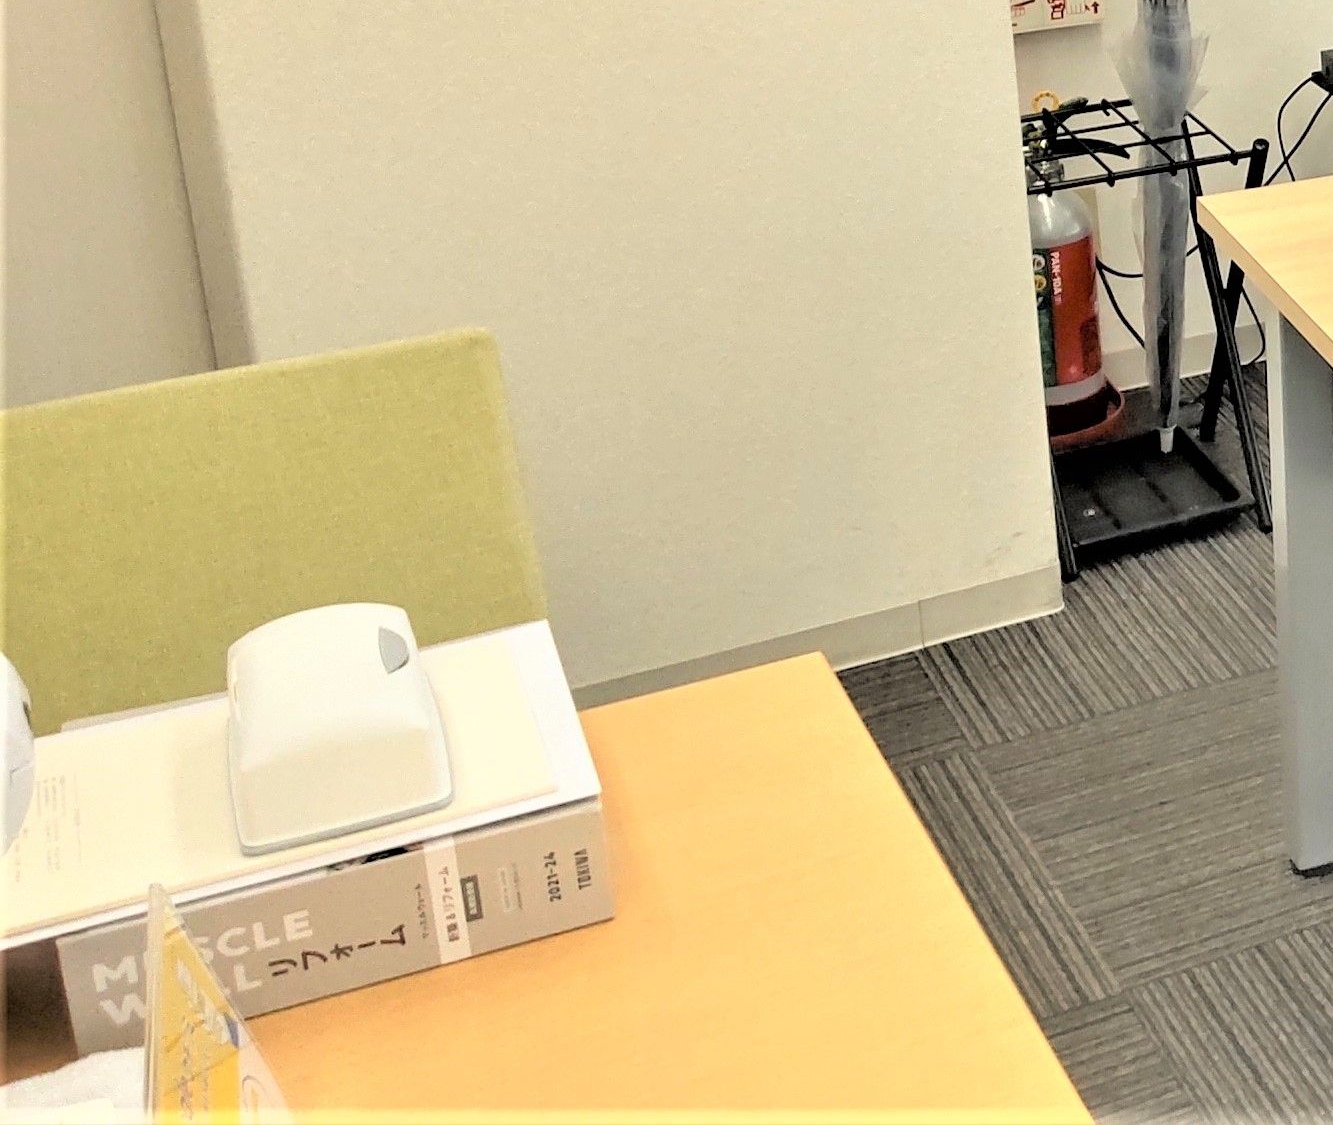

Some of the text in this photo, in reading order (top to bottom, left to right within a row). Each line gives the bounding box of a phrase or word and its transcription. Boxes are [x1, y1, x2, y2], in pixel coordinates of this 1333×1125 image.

[543, 851, 562, 903] 2021-24
[573, 847, 592, 891] TOKIWA
[268, 923, 407, 977] リフォーム
